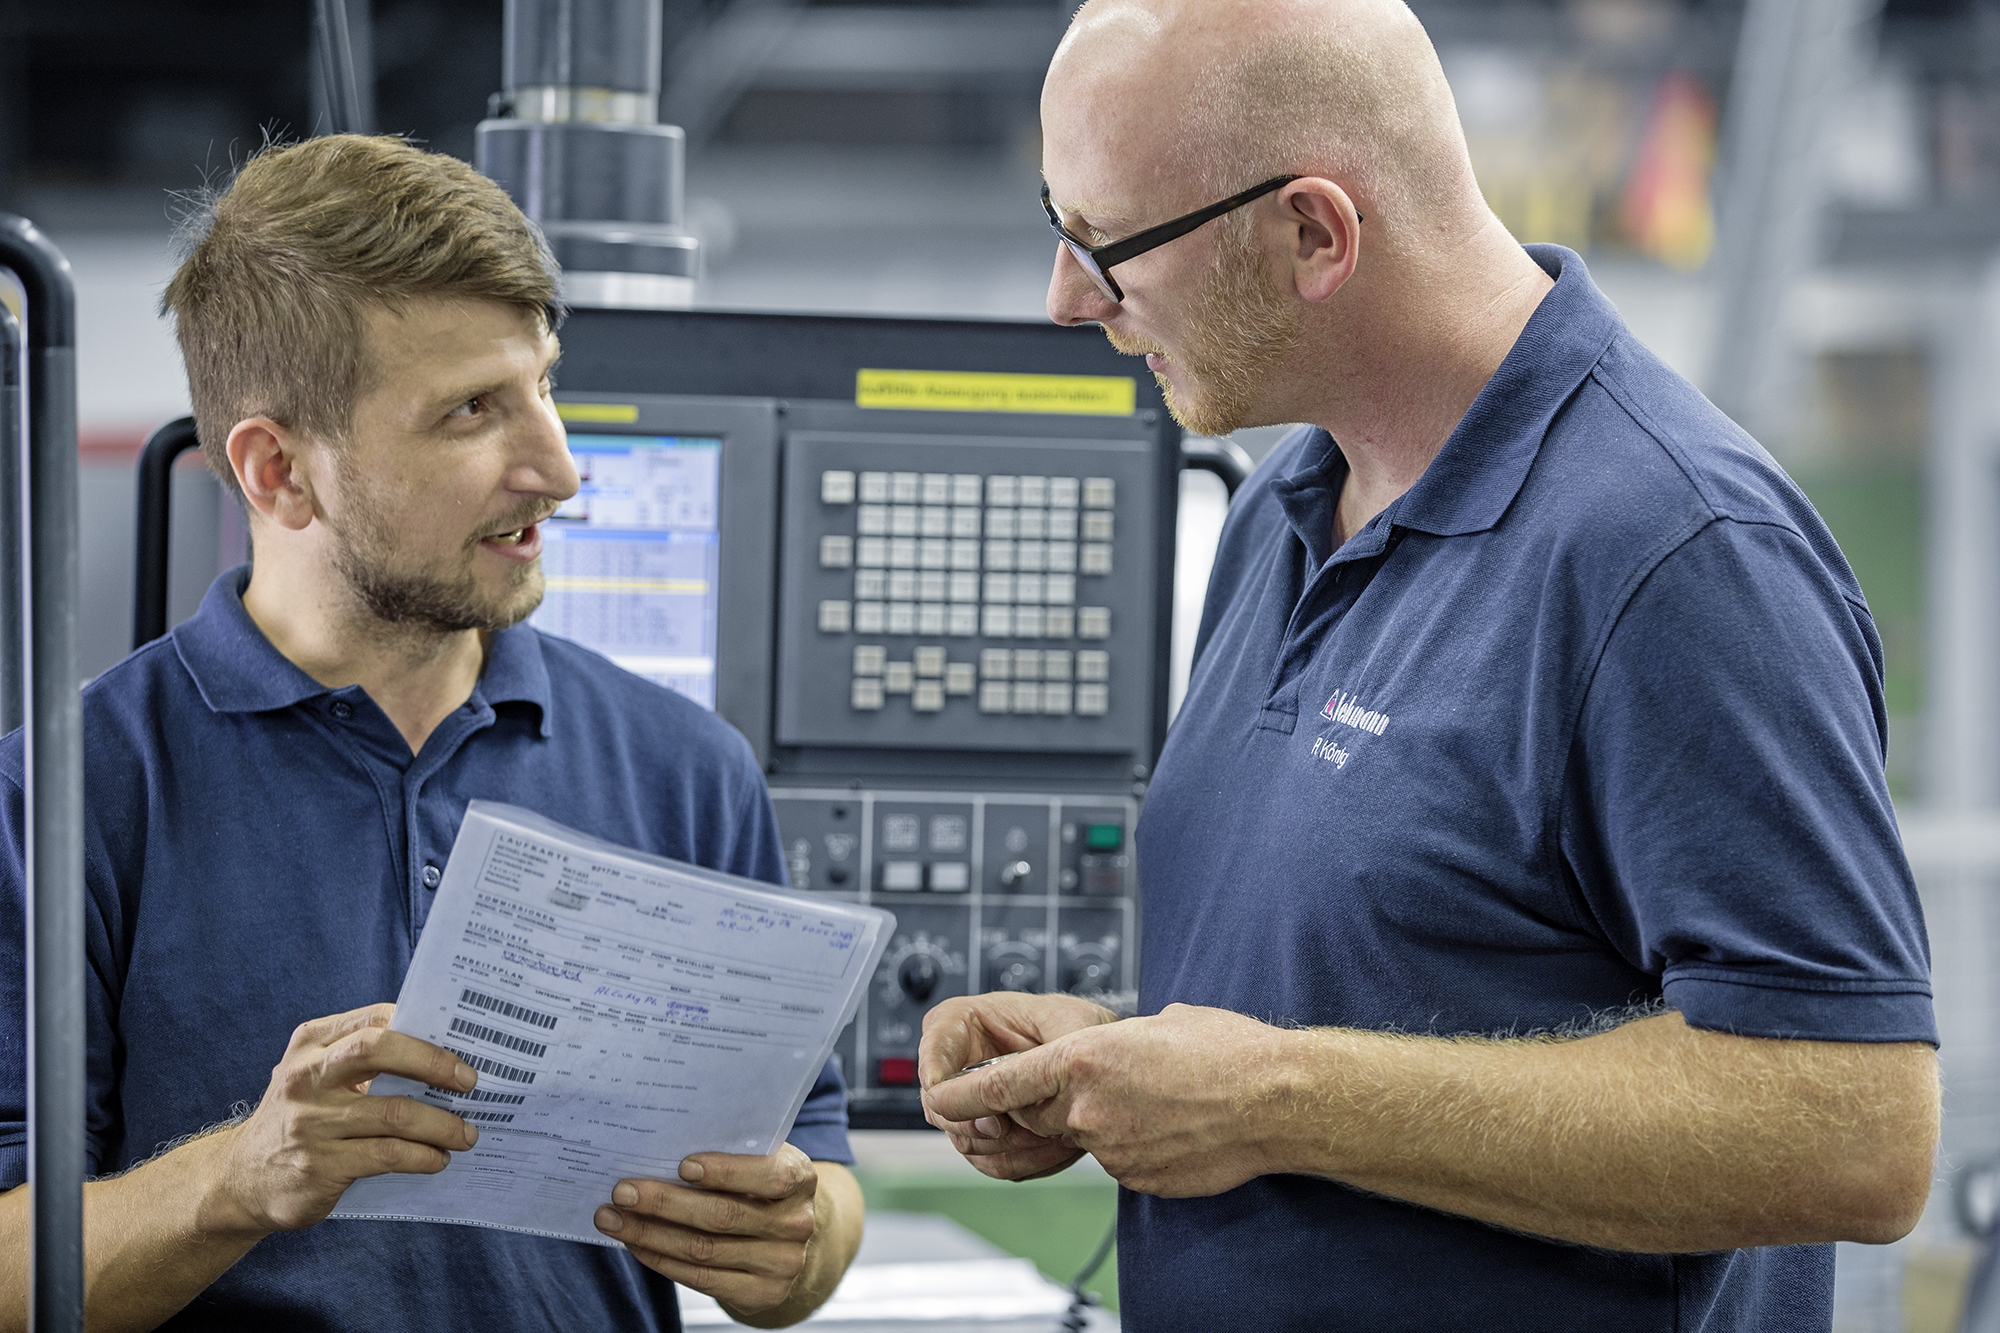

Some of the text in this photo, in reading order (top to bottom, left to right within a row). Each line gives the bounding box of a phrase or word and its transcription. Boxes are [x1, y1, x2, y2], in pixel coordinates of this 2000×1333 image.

[477, 893, 555, 922] KOMMISSIONEN
[467, 921, 529, 944] STÜCKLISTE
[454, 955, 523, 981] ARBEITSPLAN
[457, 1003, 486, 1016] Maschine
[446, 1031, 475, 1044] Maschine
[424, 1091, 453, 1103] Maschine
